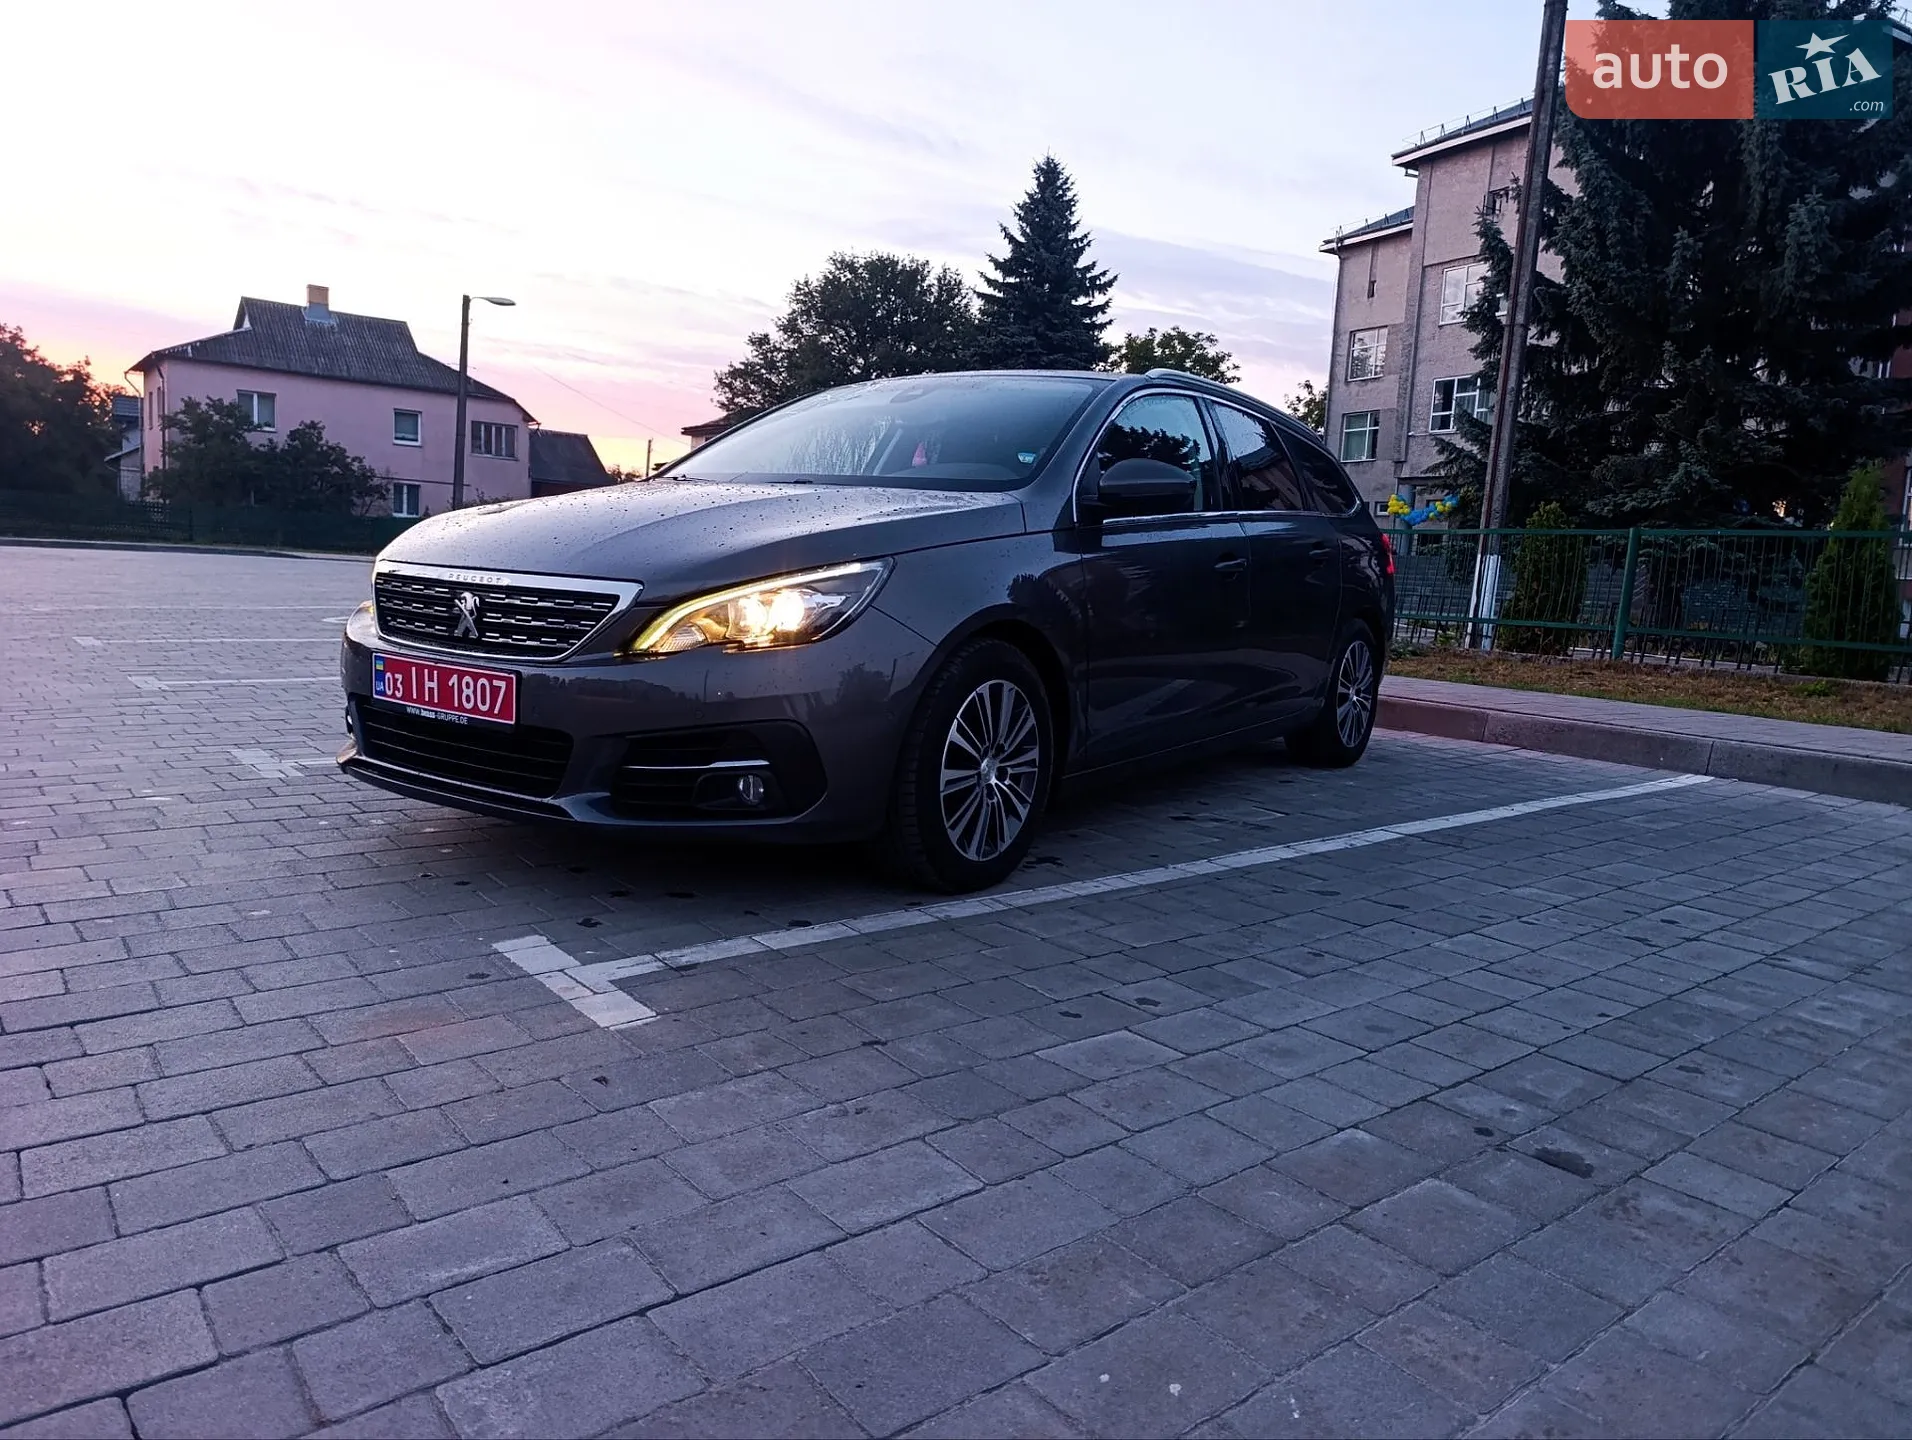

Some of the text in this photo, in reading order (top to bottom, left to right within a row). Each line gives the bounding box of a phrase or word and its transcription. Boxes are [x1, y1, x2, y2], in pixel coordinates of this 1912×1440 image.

[448, 573, 502, 584] PEUGEOT
[375, 681, 384, 691] UA
[385, 666, 507, 714] 03 IH 1807
